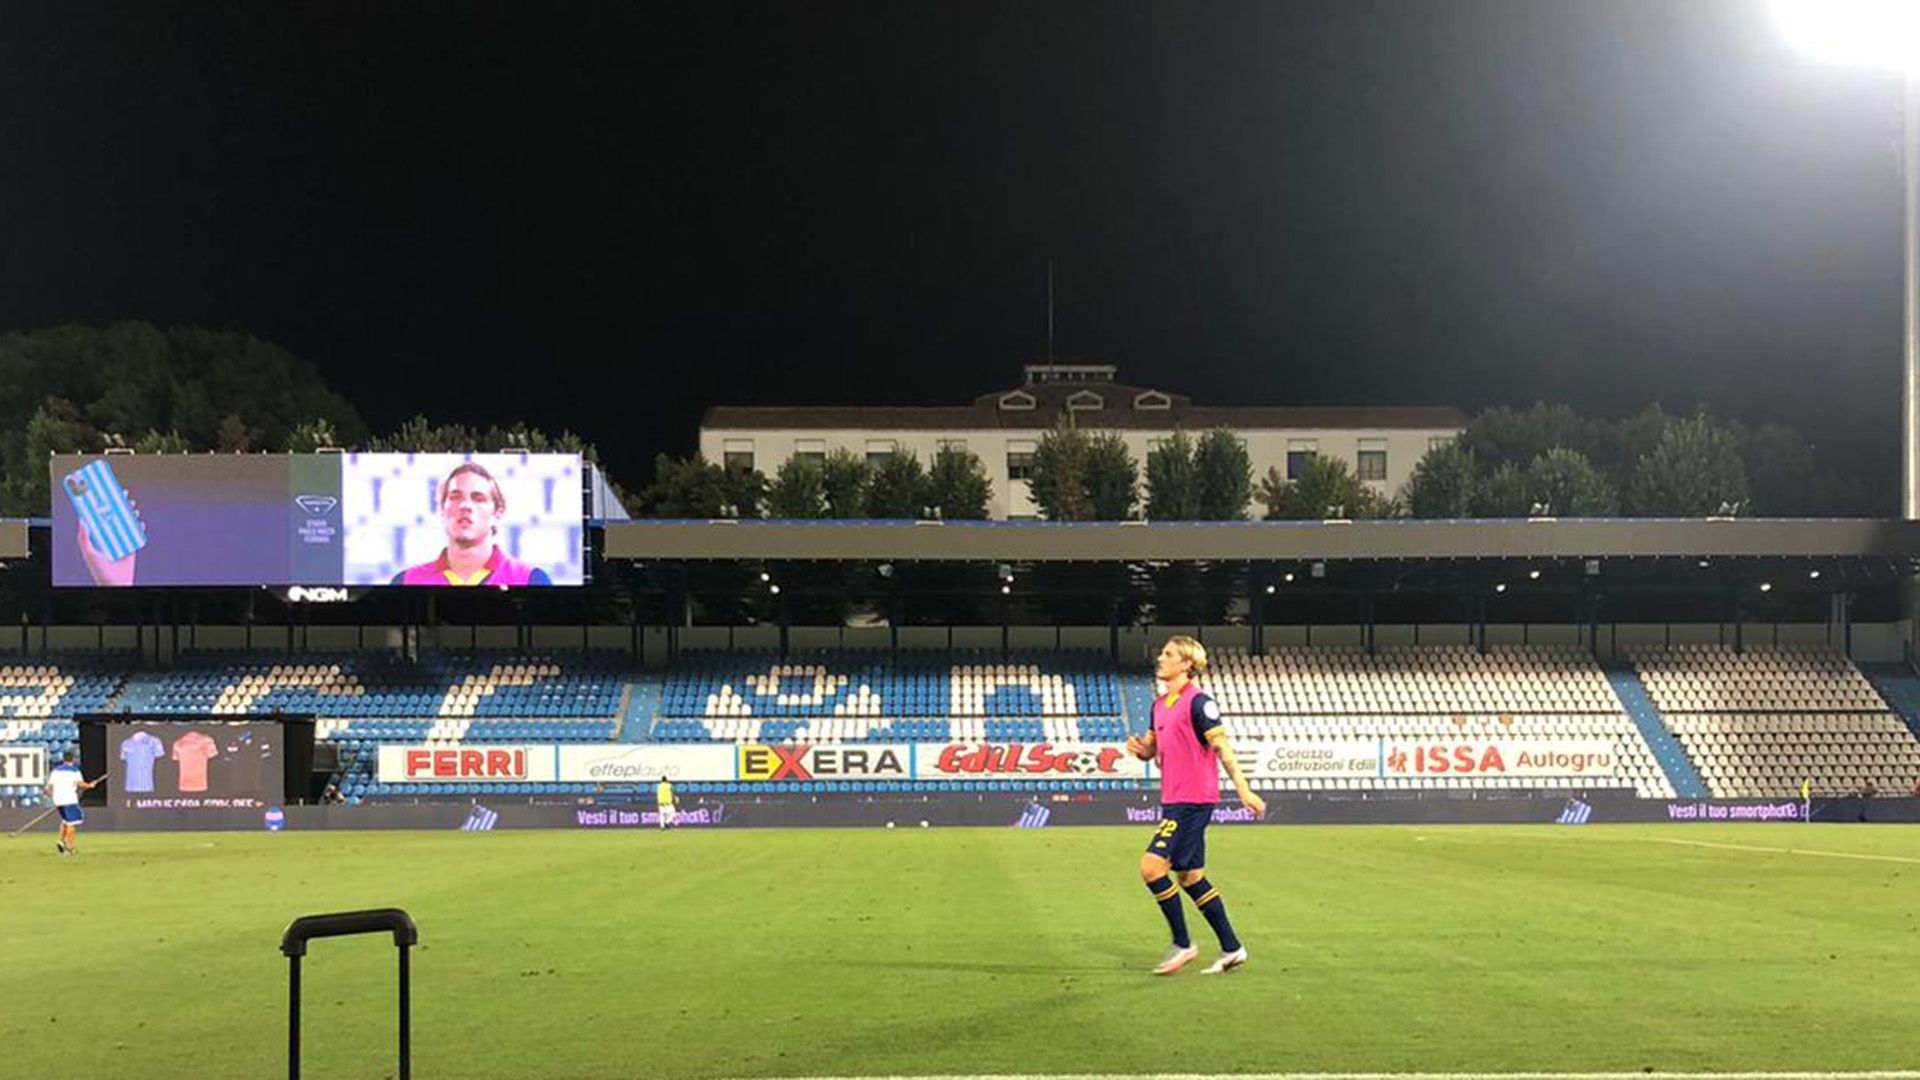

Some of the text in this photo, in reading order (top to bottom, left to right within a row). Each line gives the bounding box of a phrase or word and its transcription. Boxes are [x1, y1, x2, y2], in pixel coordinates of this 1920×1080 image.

[406, 751, 524, 776] FERRI
[745, 747, 903, 781] EXERA
[1267, 759, 1376, 772] Costruzioni Edili
[1415, 746, 1610, 772] ISSA Autogru
[578, 809, 608, 825] Vesti
[609, 809, 617, 824] il
[619, 811, 638, 824] tuo
[1126, 807, 1155, 821] Vesti
[1668, 804, 1697, 818] Vesti
[1699, 803, 1706, 817] il
[1708, 805, 1728, 818] tuo
[1730, 803, 1798, 820] smartphone
